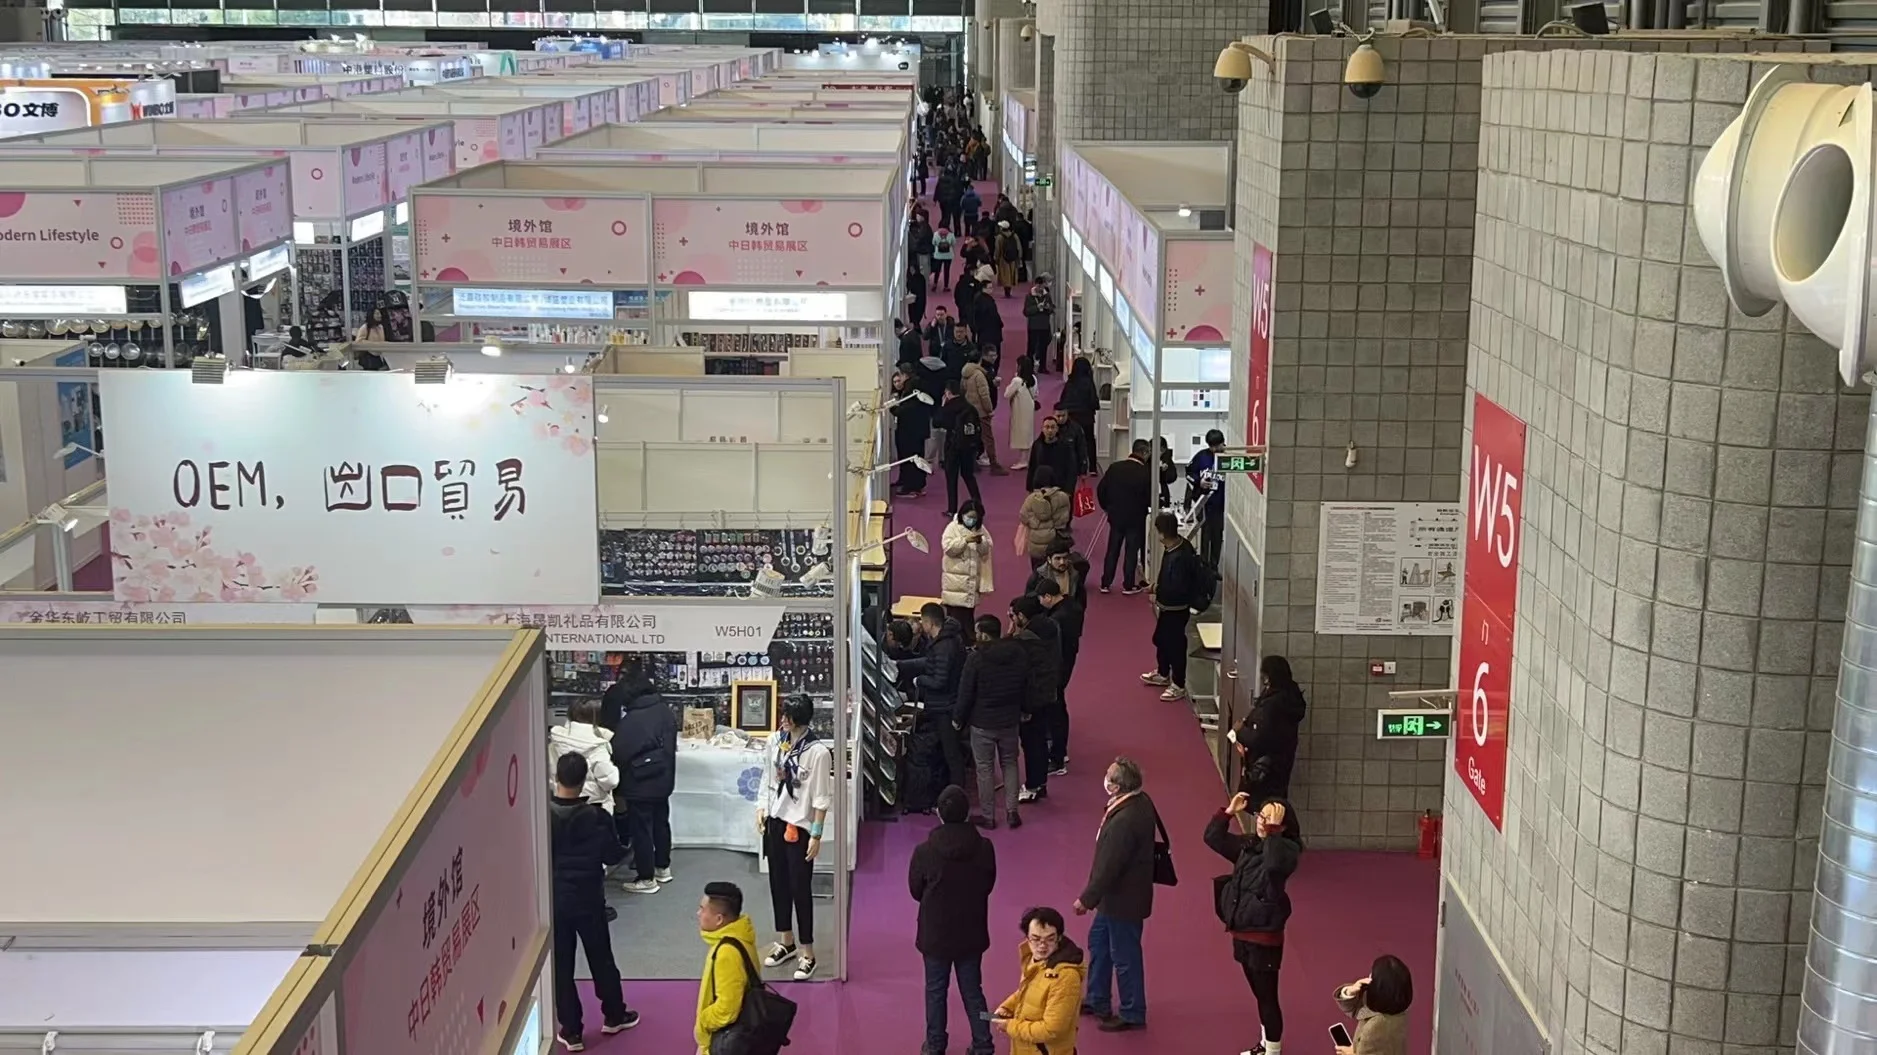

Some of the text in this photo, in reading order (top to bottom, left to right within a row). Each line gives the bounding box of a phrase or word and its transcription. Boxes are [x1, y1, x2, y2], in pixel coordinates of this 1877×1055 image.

[0, 102, 59, 117] O文博
[0, 228, 99, 244] odern Lifestyle
[508, 219, 552, 233] 境外馆
[745, 222, 789, 236] 境外馆
[492, 237, 572, 249] 中日韩贸易展区
[729, 240, 808, 252] 中日韩贸易展区
[1253, 273, 1269, 339] W5
[1253, 400, 1260, 447] 6
[173, 459, 284, 510] OEM,
[1475, 445, 1518, 568] W5
[545, 633, 665, 644] NTERNATIONAL LTD
[715, 625, 761, 637] W5H01
[1472, 661, 1490, 747] 6
[1468, 756, 1486, 795] Gate
[422, 846, 463, 949] 境外馆
[408, 883, 481, 1042] 中日韩贸易展区
